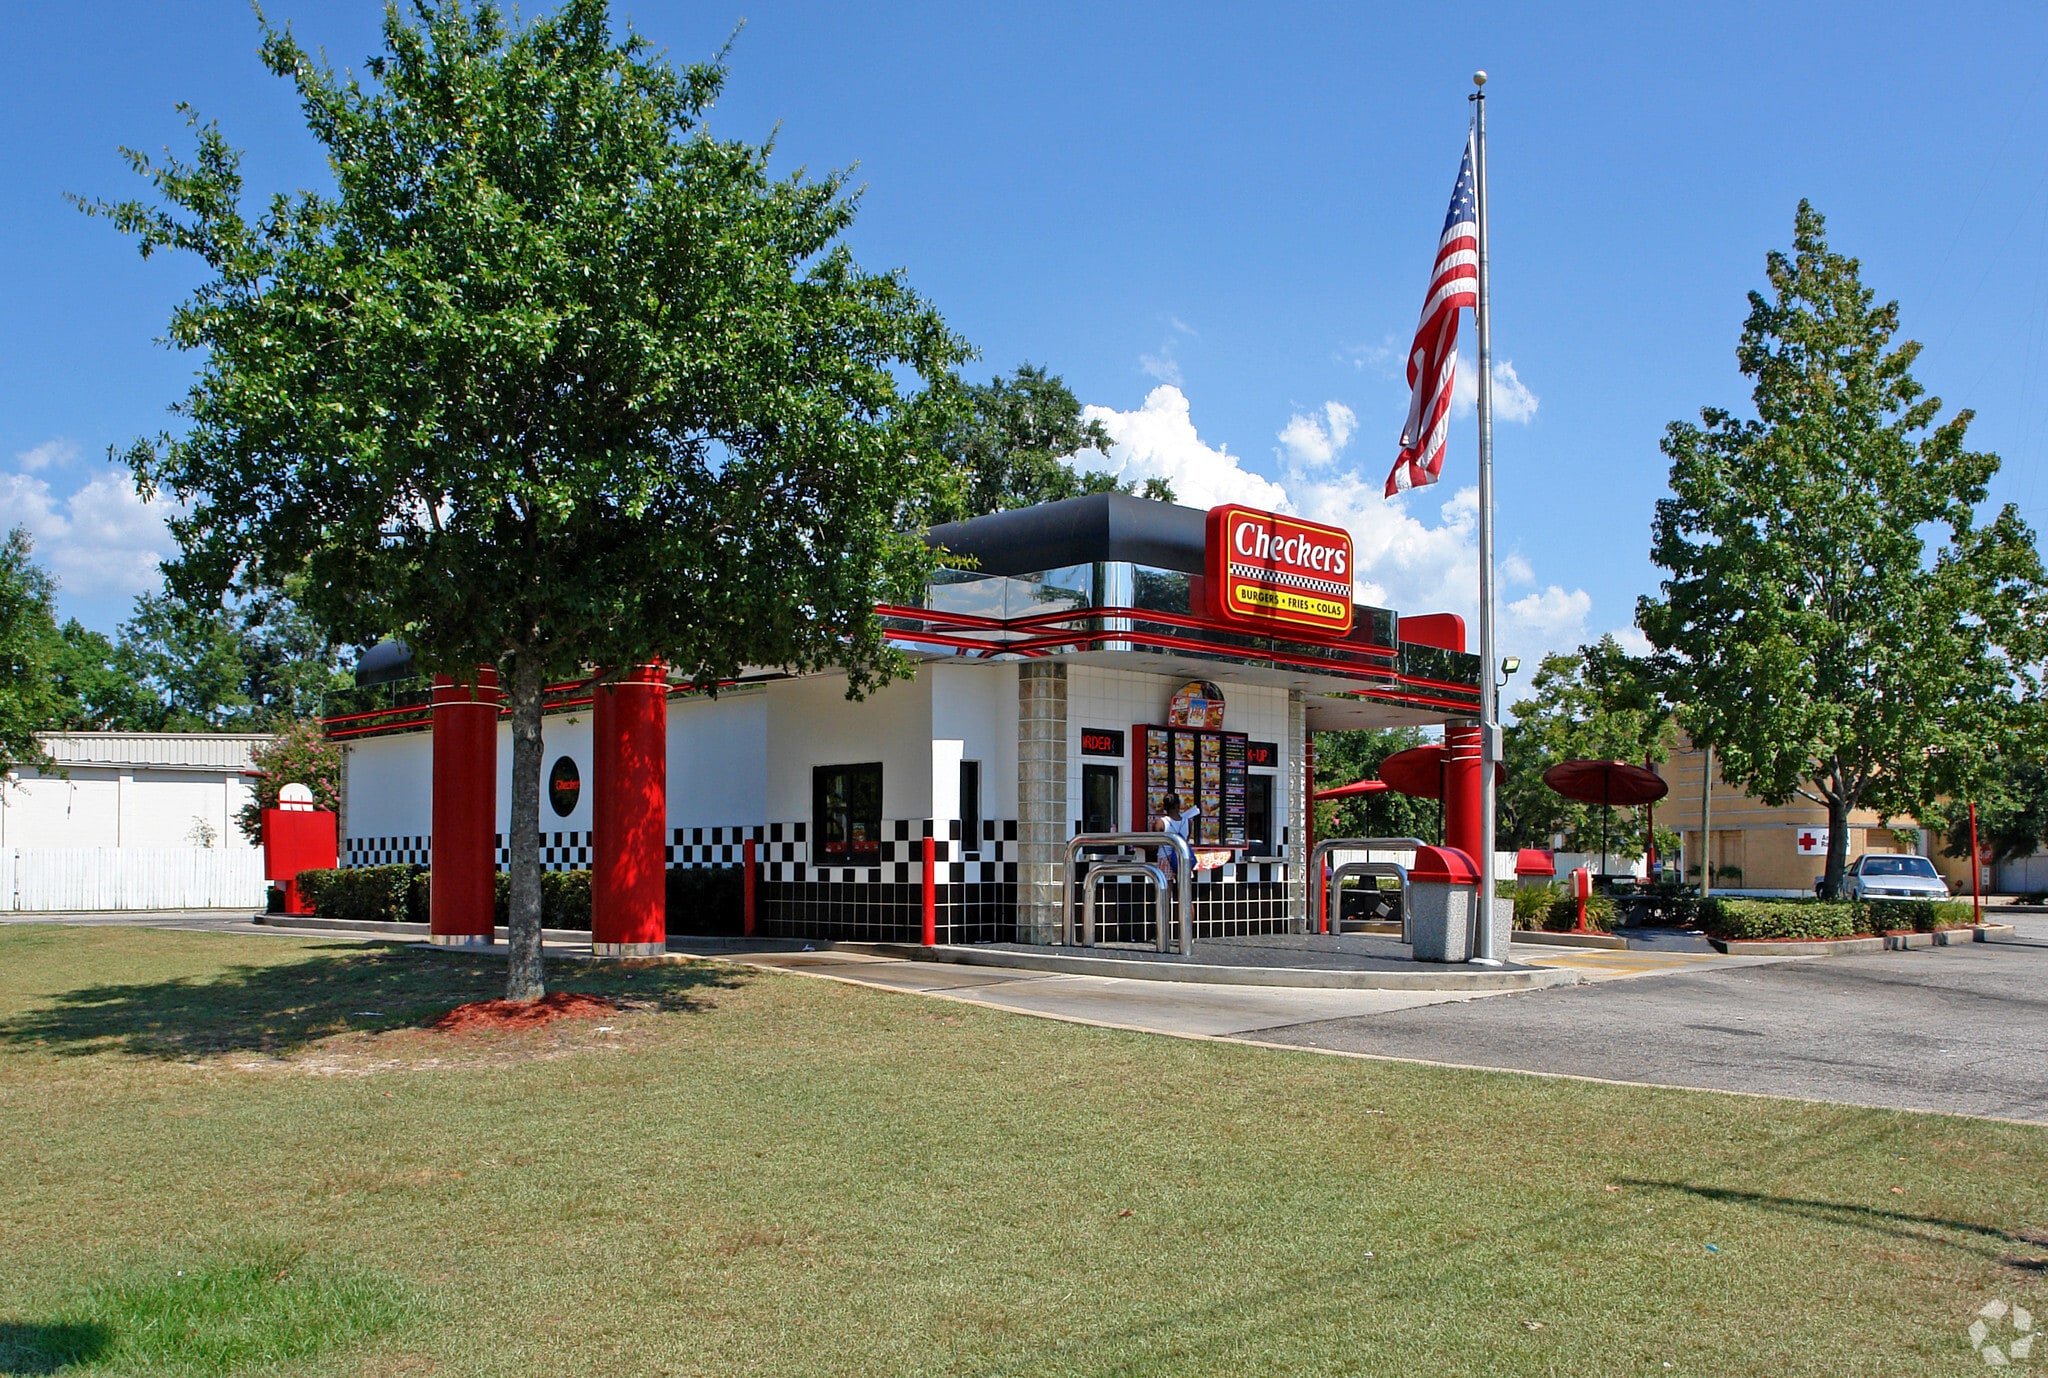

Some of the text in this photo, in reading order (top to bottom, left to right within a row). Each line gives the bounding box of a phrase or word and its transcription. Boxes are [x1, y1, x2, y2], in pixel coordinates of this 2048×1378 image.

[1235, 522, 1346, 575] Checkers
[1241, 589, 1342, 616] BURGERS FRIES COLAS
